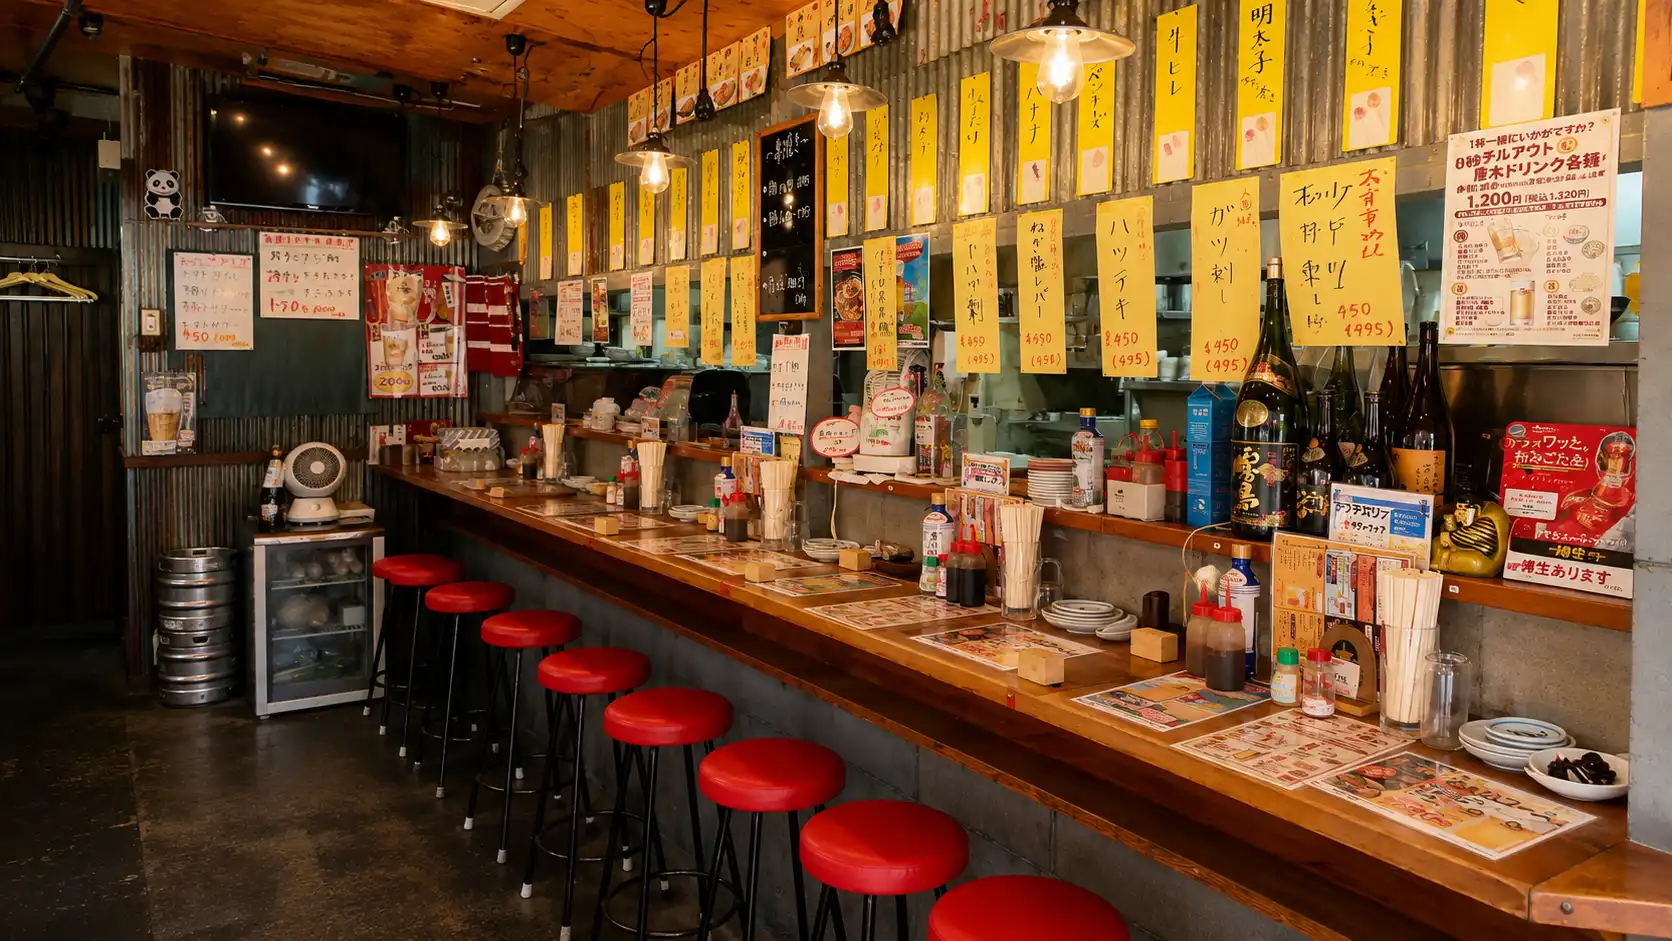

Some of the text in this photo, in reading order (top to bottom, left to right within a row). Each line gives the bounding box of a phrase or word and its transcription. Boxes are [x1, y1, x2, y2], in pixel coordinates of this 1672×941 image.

[1250, 3, 1273, 74] 明太子
[1112, 350, 1150, 369] (495)
[1206, 356, 1248, 373] (495)
